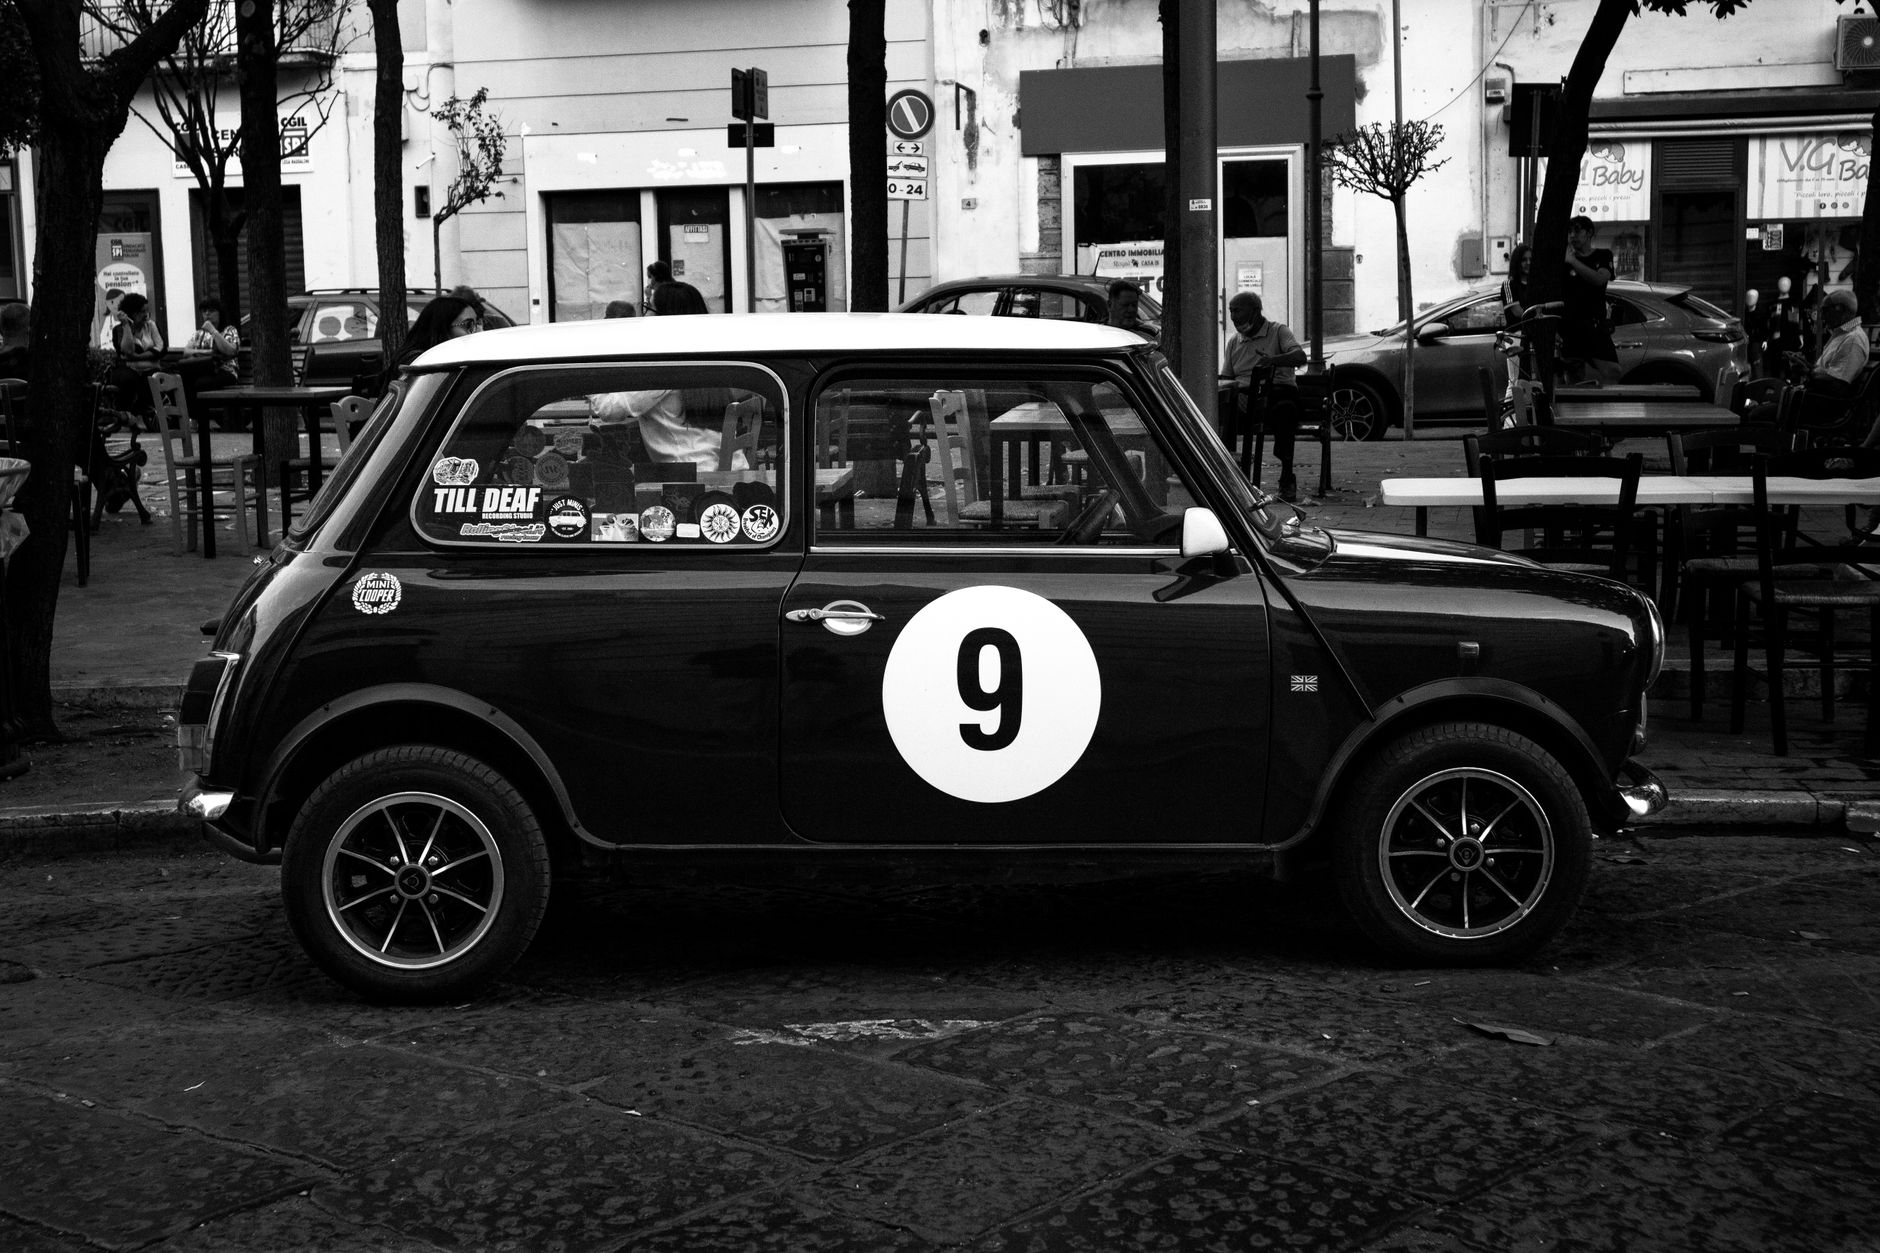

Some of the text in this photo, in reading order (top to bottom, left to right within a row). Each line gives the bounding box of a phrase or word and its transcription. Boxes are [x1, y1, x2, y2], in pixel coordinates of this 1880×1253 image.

[281, 117, 308, 127] CGIL
[1593, 162, 1645, 191] Baby
[888, 183, 897, 194] 0
[906, 184, 924, 196] 24
[1100, 250, 1126, 258] CENTRO
[434, 488, 541, 513] TILL DEAF
[552, 499, 583, 511] JUST MINIS
[749, 506, 775, 527] SEX
[366, 580, 390, 589] MINI
[359, 589, 395, 602] COOPER
[957, 627, 1023, 751] 9
